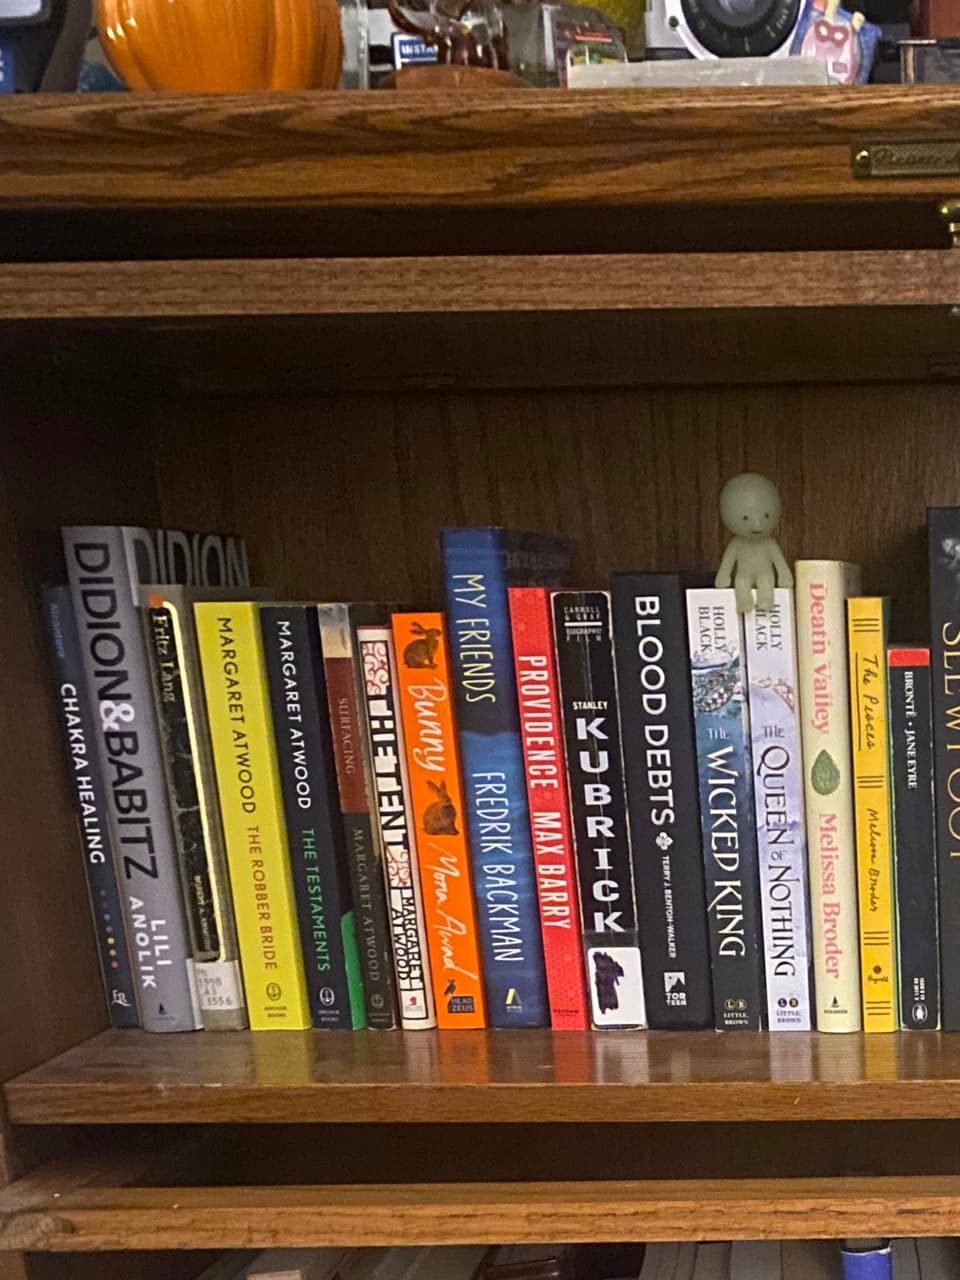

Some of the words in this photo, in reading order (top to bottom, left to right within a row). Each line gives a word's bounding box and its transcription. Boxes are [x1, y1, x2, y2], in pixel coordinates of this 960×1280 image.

[452, 574, 484, 610] MY
[808, 583, 829, 655] Death
[218, 617, 244, 723] MARGARET
[277, 621, 302, 721] MARGARET
[461, 620, 496, 703] FRIENDS
[809, 662, 832, 734] Valley
[862, 655, 878, 686] The
[337, 698, 356, 775] SURFACING
[367, 694, 395, 757] THE
[518, 656, 559, 788] PROVIDENCE
[572, 701, 608, 710] STANLEY
[862, 695, 879, 750] Pisces
[905, 729, 916, 756] JANE
[60, 683, 88, 770] CHAKRA
[78, 776, 105, 864] HEALING
[232, 730, 256, 814] ATWOOD
[289, 728, 311, 809] ATWOOD
[906, 759, 918, 789] EYRE
[247, 826, 263, 854] THE
[301, 829, 317, 860] THE
[374, 767, 407, 849] TENT
[472, 772, 512, 854] FREDRIK
[530, 812, 563, 856] MAX
[576, 717, 625, 934] KUBRICK
[706, 746, 739, 869] WICKED
[251, 860, 271, 920] ROBBER
[352, 829, 373, 909] MARGARET
[817, 813, 839, 895] Melissa
[306, 866, 330, 972] TESTAMENTS
[485, 865, 523, 961] BACKMAN
[539, 864, 570, 929] BARRY
[708, 879, 745, 957] KING
[130, 897, 156, 988] ANOLIK
[151, 920, 172, 967] LILI
[261, 925, 278, 970] BRIDE
[359, 915, 380, 981] ATWOOD
[822, 902, 843, 979] Broder
